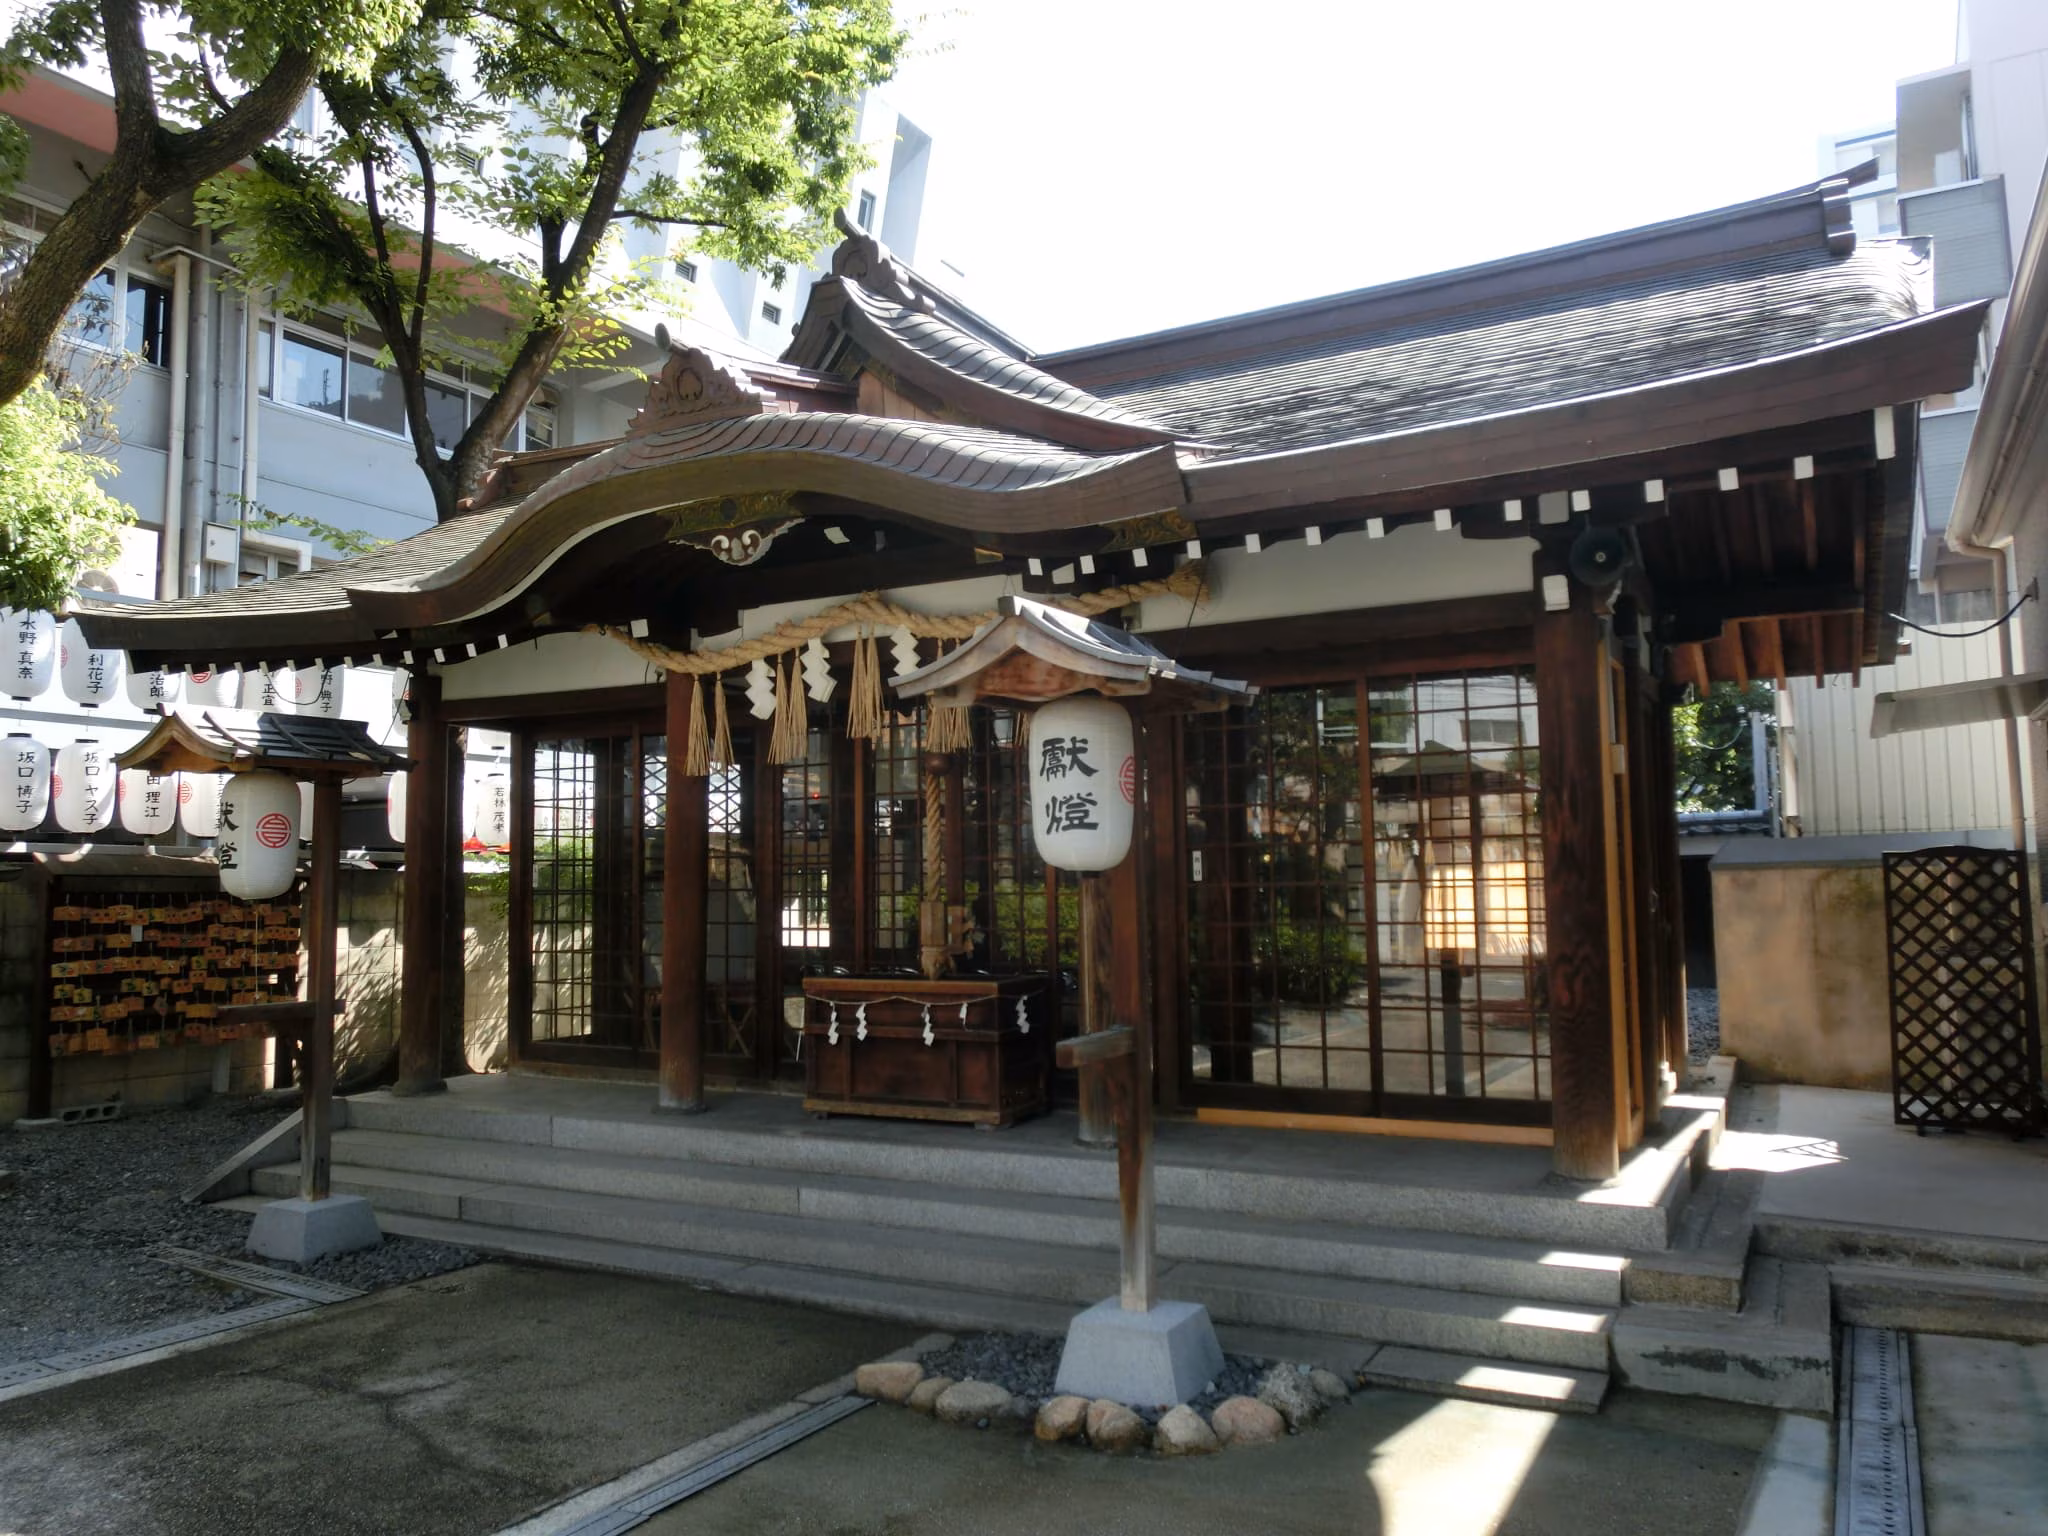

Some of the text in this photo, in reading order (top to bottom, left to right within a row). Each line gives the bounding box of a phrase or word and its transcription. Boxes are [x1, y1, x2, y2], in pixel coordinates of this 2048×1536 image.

[86, 654, 104, 694] 利花子
[149, 673, 165, 698] 治郎
[261, 669, 277, 706] 正宜
[16, 751, 36, 814] 坂口博子
[82, 751, 101, 825] 坂口ヤス子
[144, 775, 161, 818] 田理江
